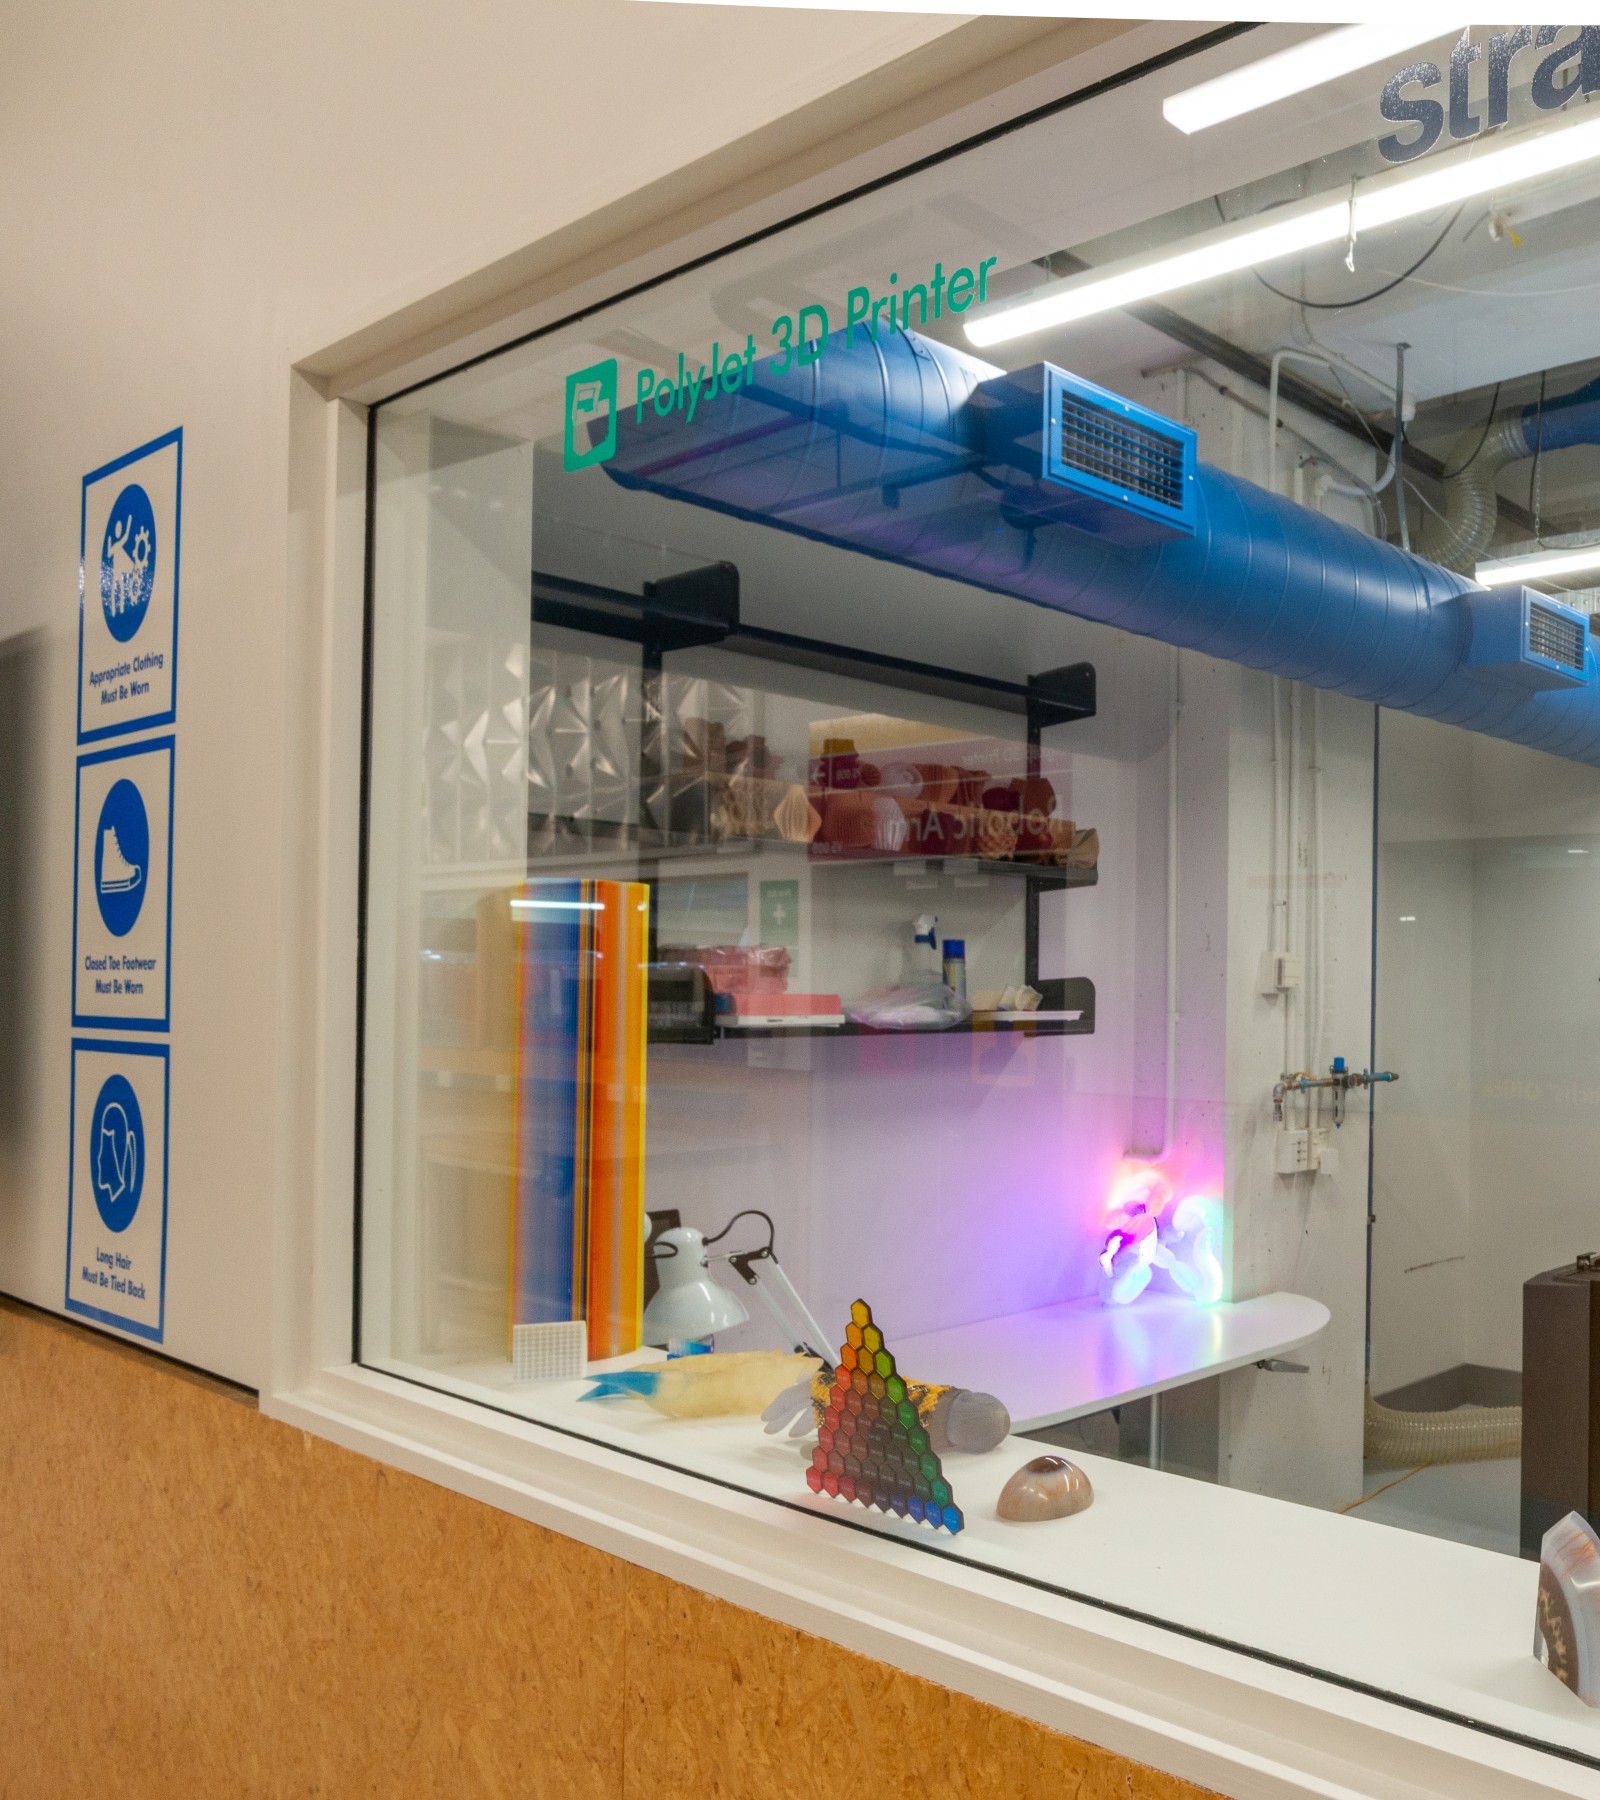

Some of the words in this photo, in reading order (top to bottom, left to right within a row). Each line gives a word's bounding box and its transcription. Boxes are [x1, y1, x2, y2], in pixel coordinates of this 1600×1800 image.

[636, 334, 756, 425] PolyJet
[769, 303, 829, 377] 3D
[846, 256, 997, 350] Printer
[90, 662, 131, 688] Appropriate
[133, 652, 163, 672] Clothing
[101, 688, 117, 705] Must
[119, 685, 128, 700] Be
[130, 681, 149, 697] Worn
[85, 955, 107, 970] Closed
[109, 955, 120, 970] Toe
[123, 955, 156, 970] Footwear
[96, 979, 112, 994] Must
[114, 979, 122, 994] Be
[124, 979, 143, 994] Worn
[96, 1247, 113, 1269] Long
[115, 1252, 131, 1270] Hair
[82, 1266, 98, 1284] Must
[99, 1272, 108, 1288] Be
[111, 1275, 125, 1293] Tied
[128, 1280, 145, 1299] Back
